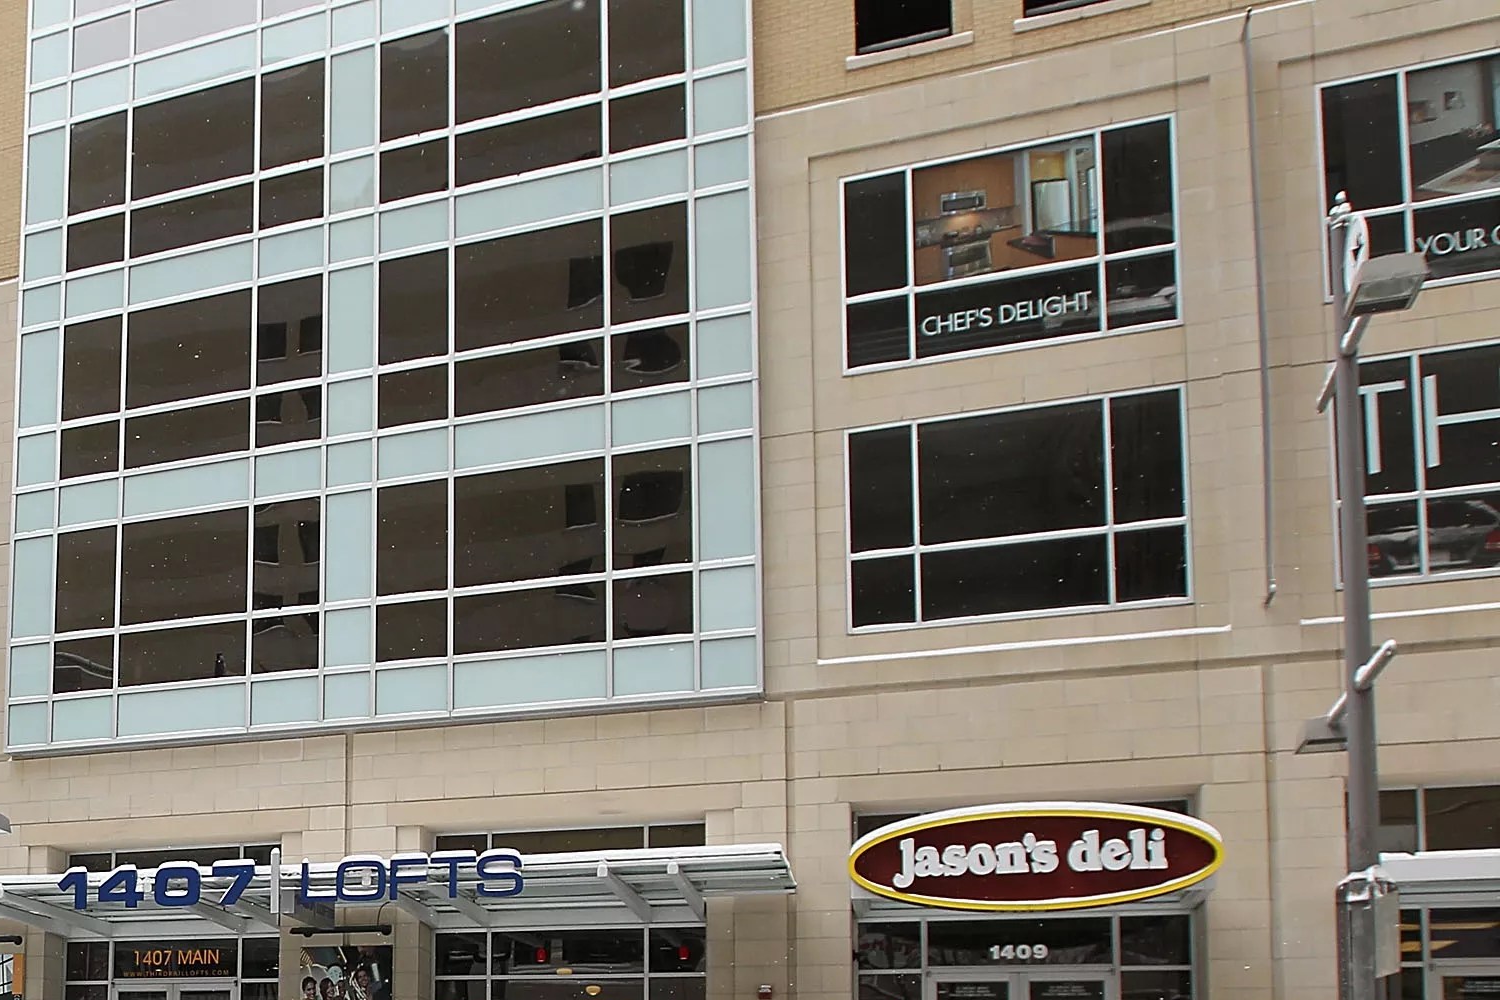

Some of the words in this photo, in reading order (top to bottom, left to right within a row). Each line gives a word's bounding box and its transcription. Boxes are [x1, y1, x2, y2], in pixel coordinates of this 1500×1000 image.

[1416, 228, 1488, 257] YOUR
[921, 307, 993, 336] CHEF'S
[999, 290, 1092, 324] DELIGHT
[892, 832, 1060, 889] Jason's
[1068, 828, 1169, 873] deli
[57, 862, 256, 910] 1407
[301, 855, 523, 902] LOFTS
[134, 950, 172, 966] 1407
[178, 949, 220, 966] MAIN
[989, 944, 1049, 960] 1409
